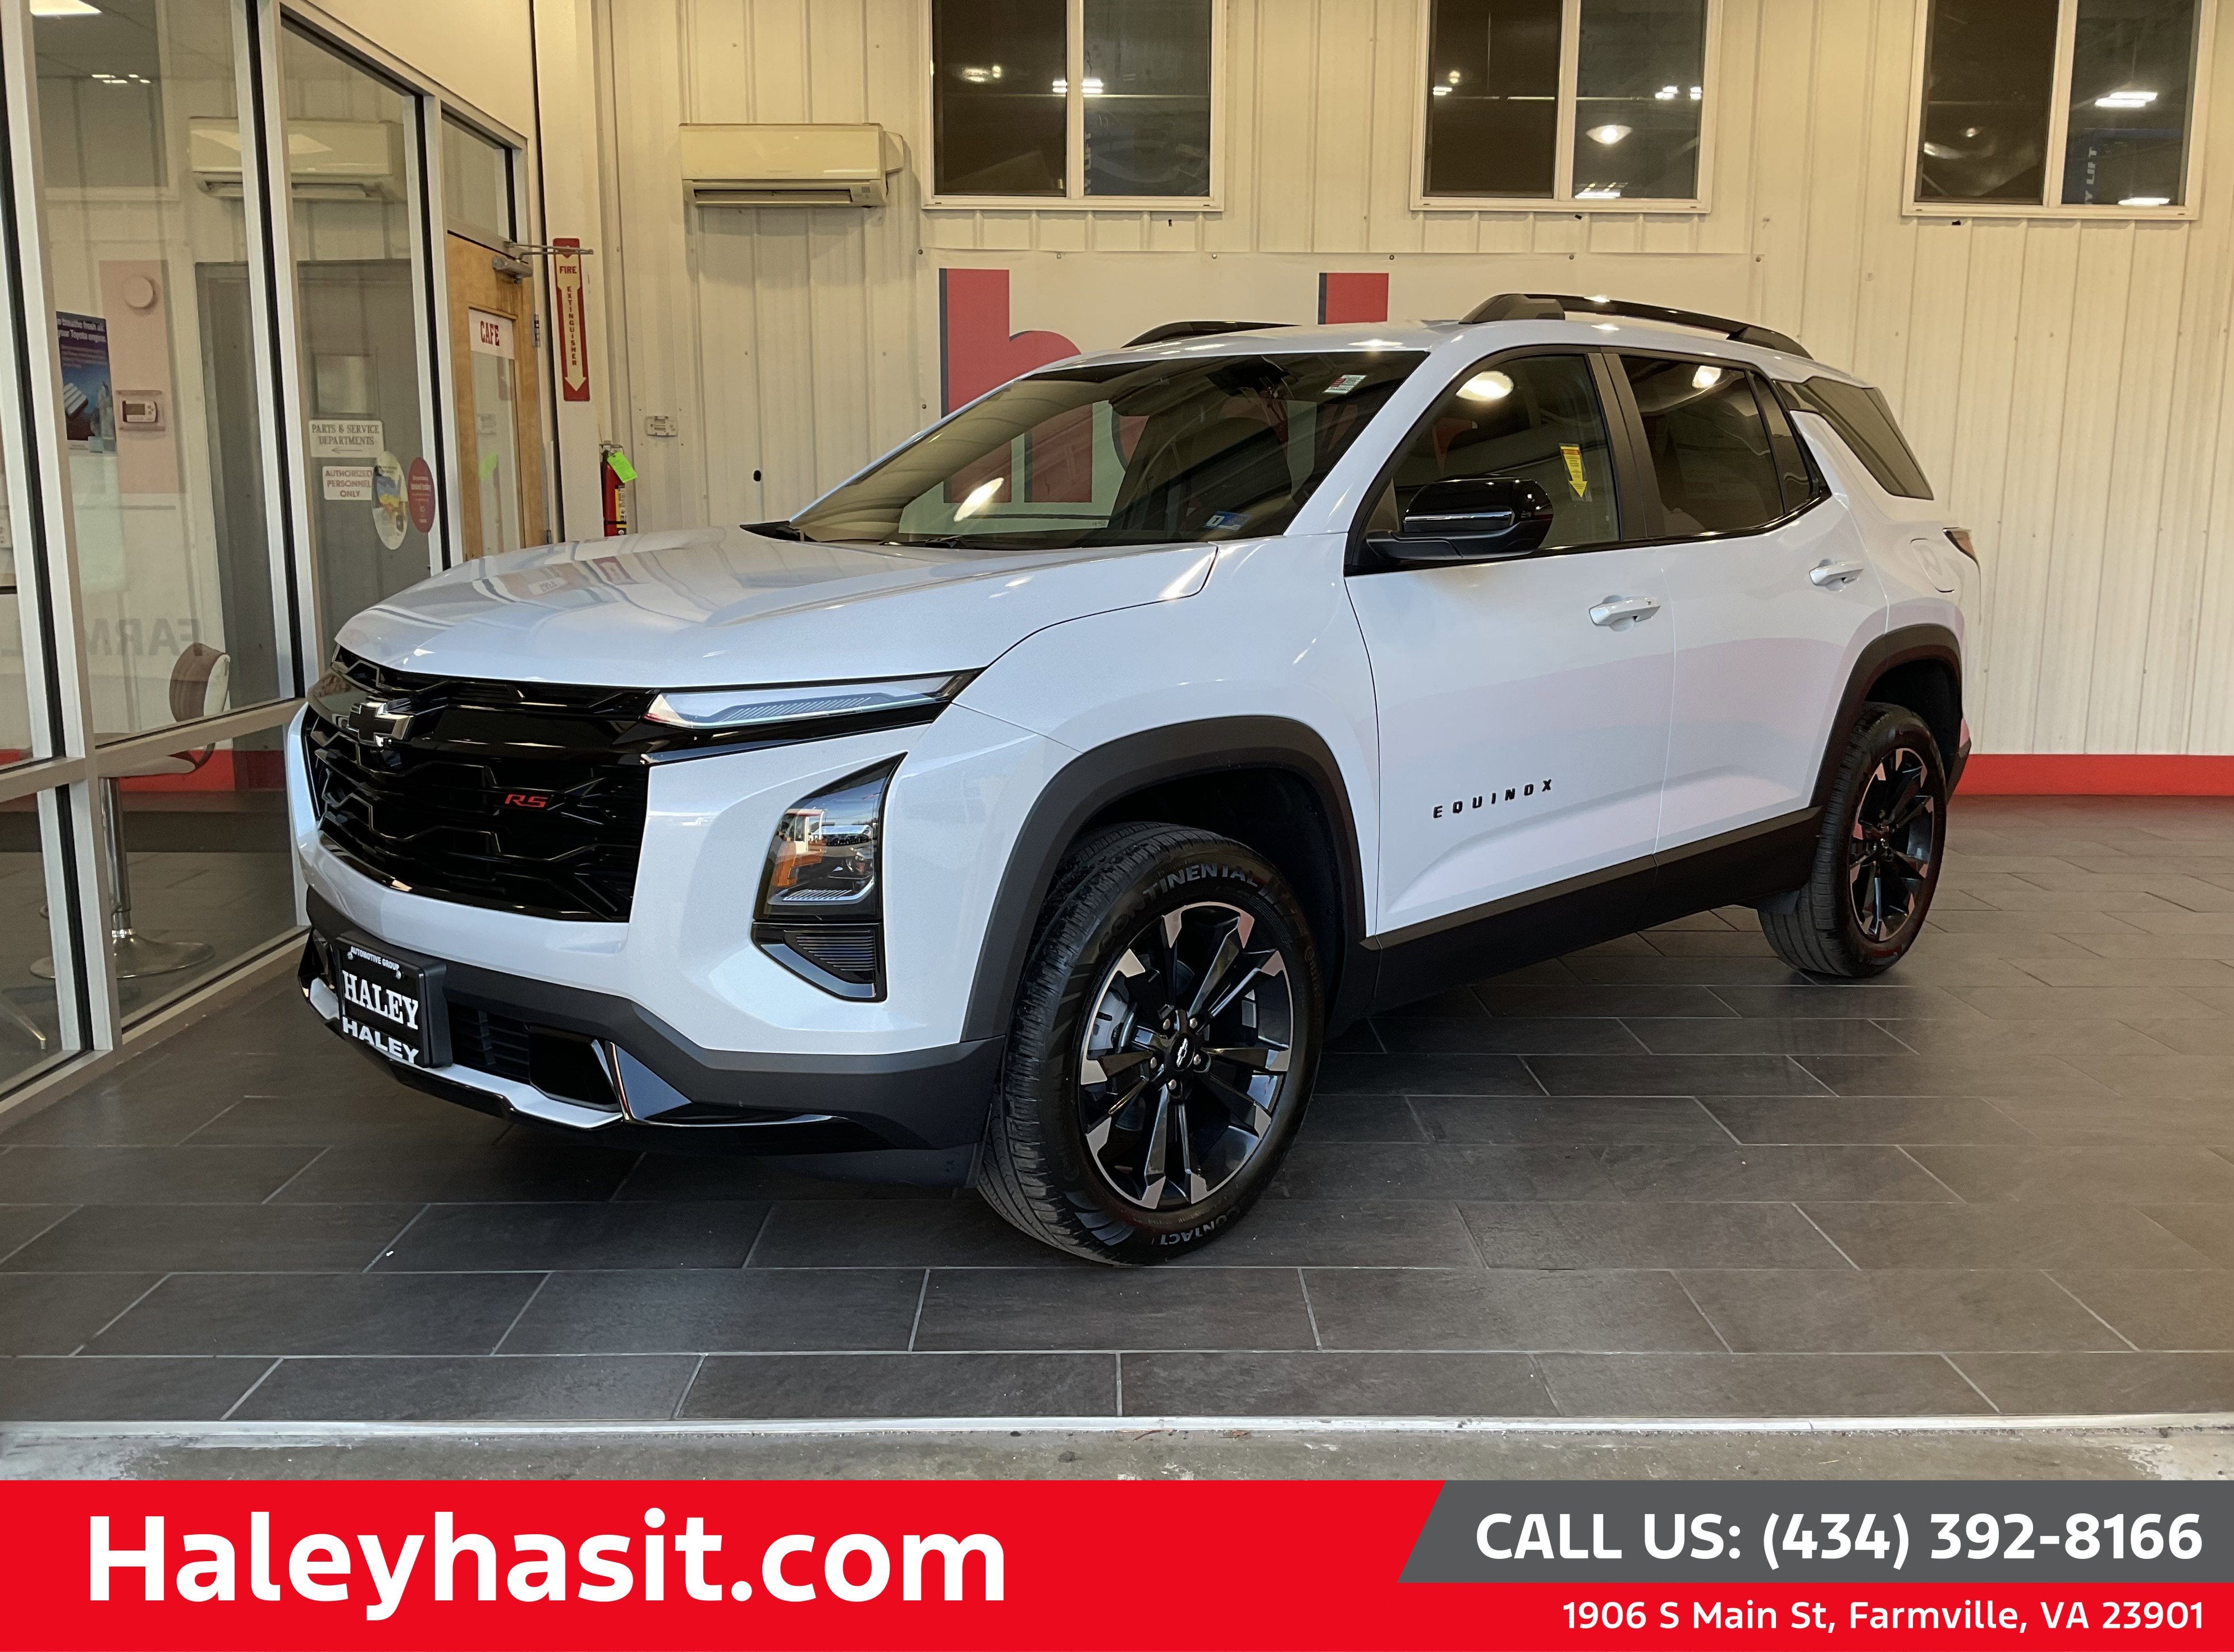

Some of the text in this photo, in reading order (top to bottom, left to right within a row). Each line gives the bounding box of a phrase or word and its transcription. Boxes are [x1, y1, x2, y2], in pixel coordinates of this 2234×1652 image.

[2086, 147, 2097, 184] LIFT
[480, 320, 500, 346] CAFE
[567, 286, 577, 366] EXTINGUISHER
[312, 424, 379, 434] PARTS & SERVICE
[318, 436, 374, 445] DEPARTMENTS
[505, 794, 548, 807] RS
[1433, 779, 1551, 818] EQUINOX
[350, 946, 400, 971] AUTOMOTIVE GROUP
[342, 970, 419, 1030] HALEY
[342, 1016, 420, 1064] HALEY
